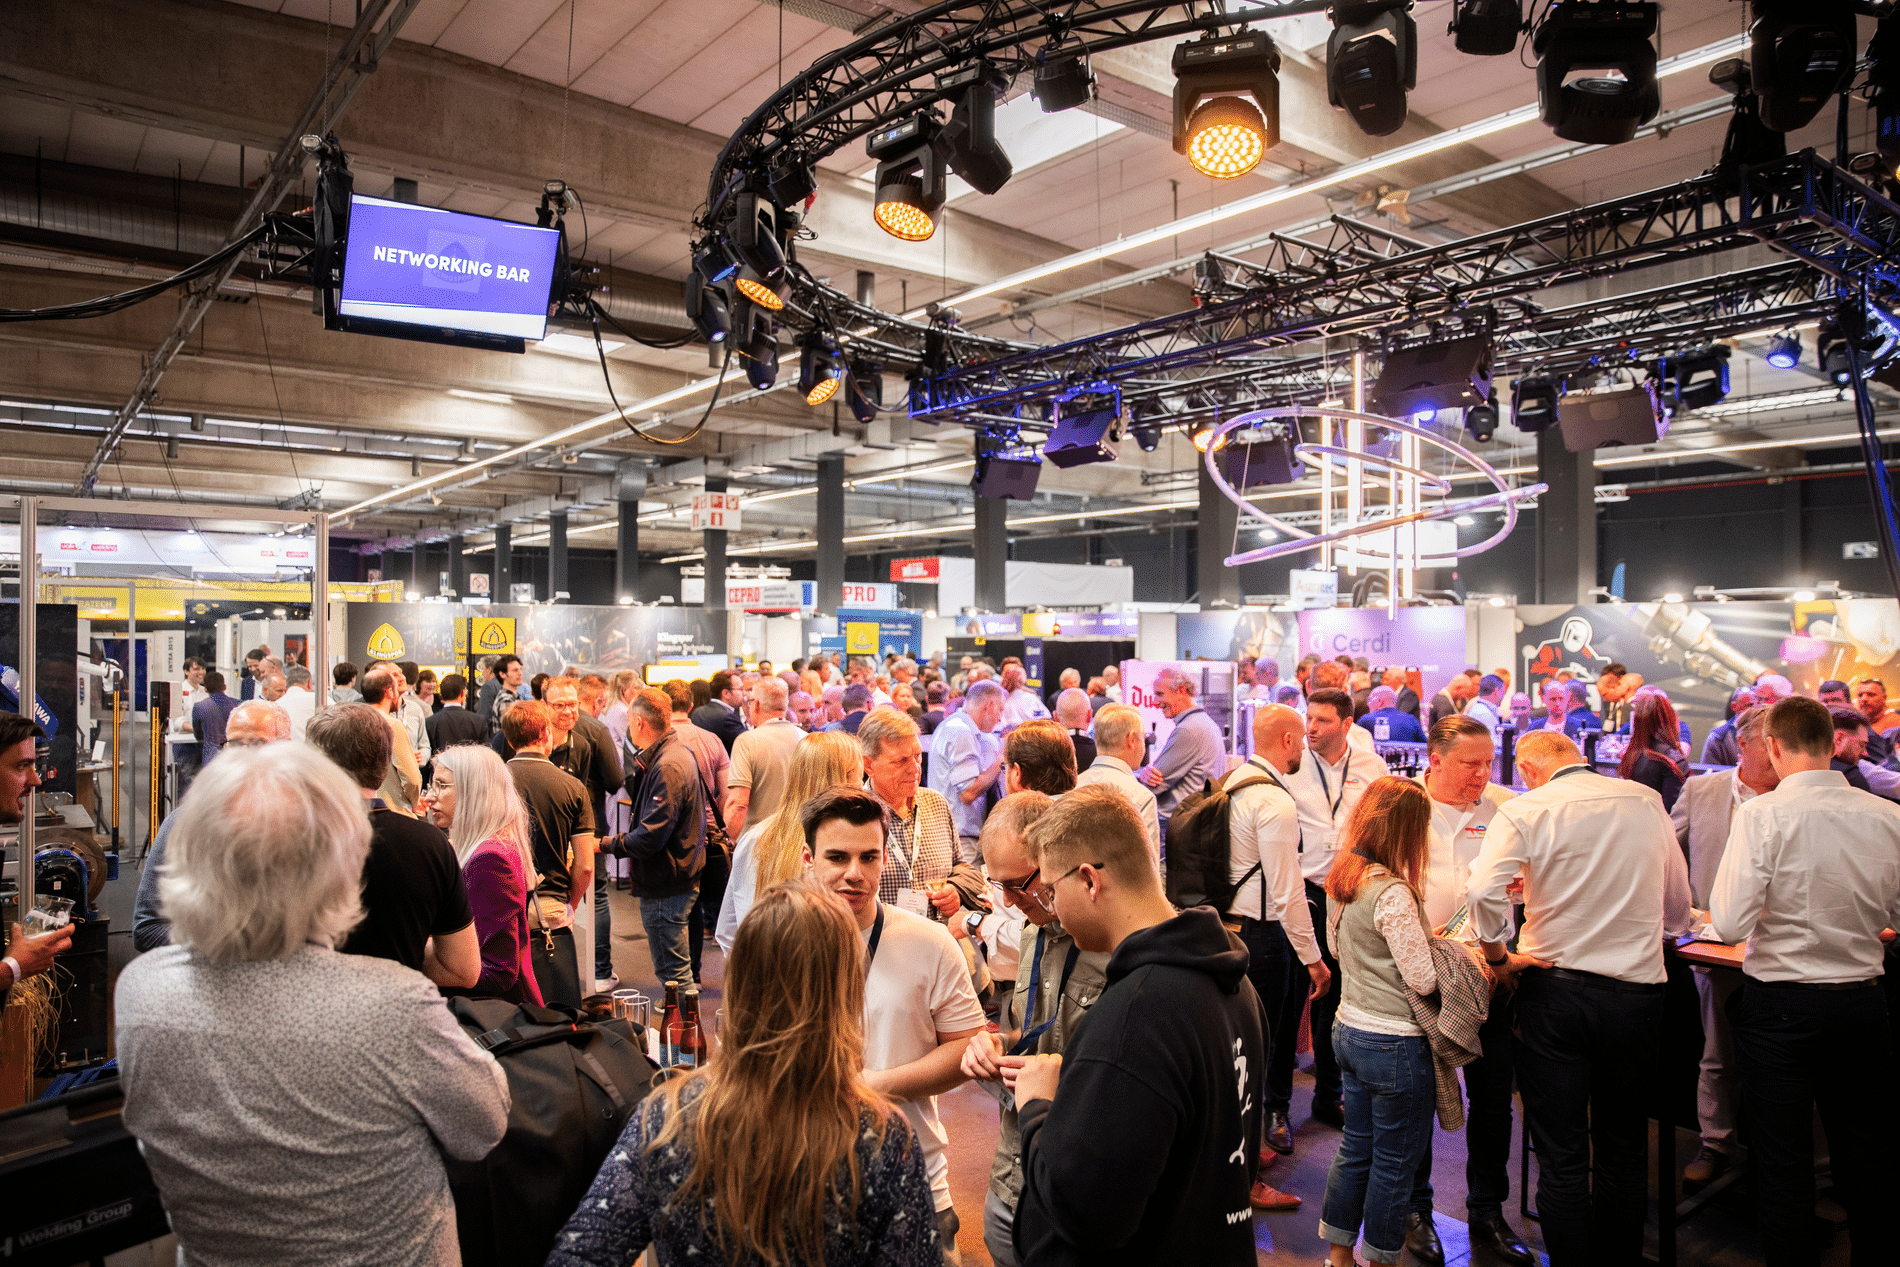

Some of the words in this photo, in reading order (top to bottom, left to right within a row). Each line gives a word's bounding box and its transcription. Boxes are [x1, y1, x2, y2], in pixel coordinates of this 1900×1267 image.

[373, 245, 492, 278] NETWORKING
[496, 265, 530, 283] BAR
[729, 587, 760, 603] CEPRO
[842, 585, 876, 602] PRO
[1333, 633, 1391, 653] Cerdi
[18, 1218, 82, 1247] Welding
[86, 1202, 133, 1225] Group
